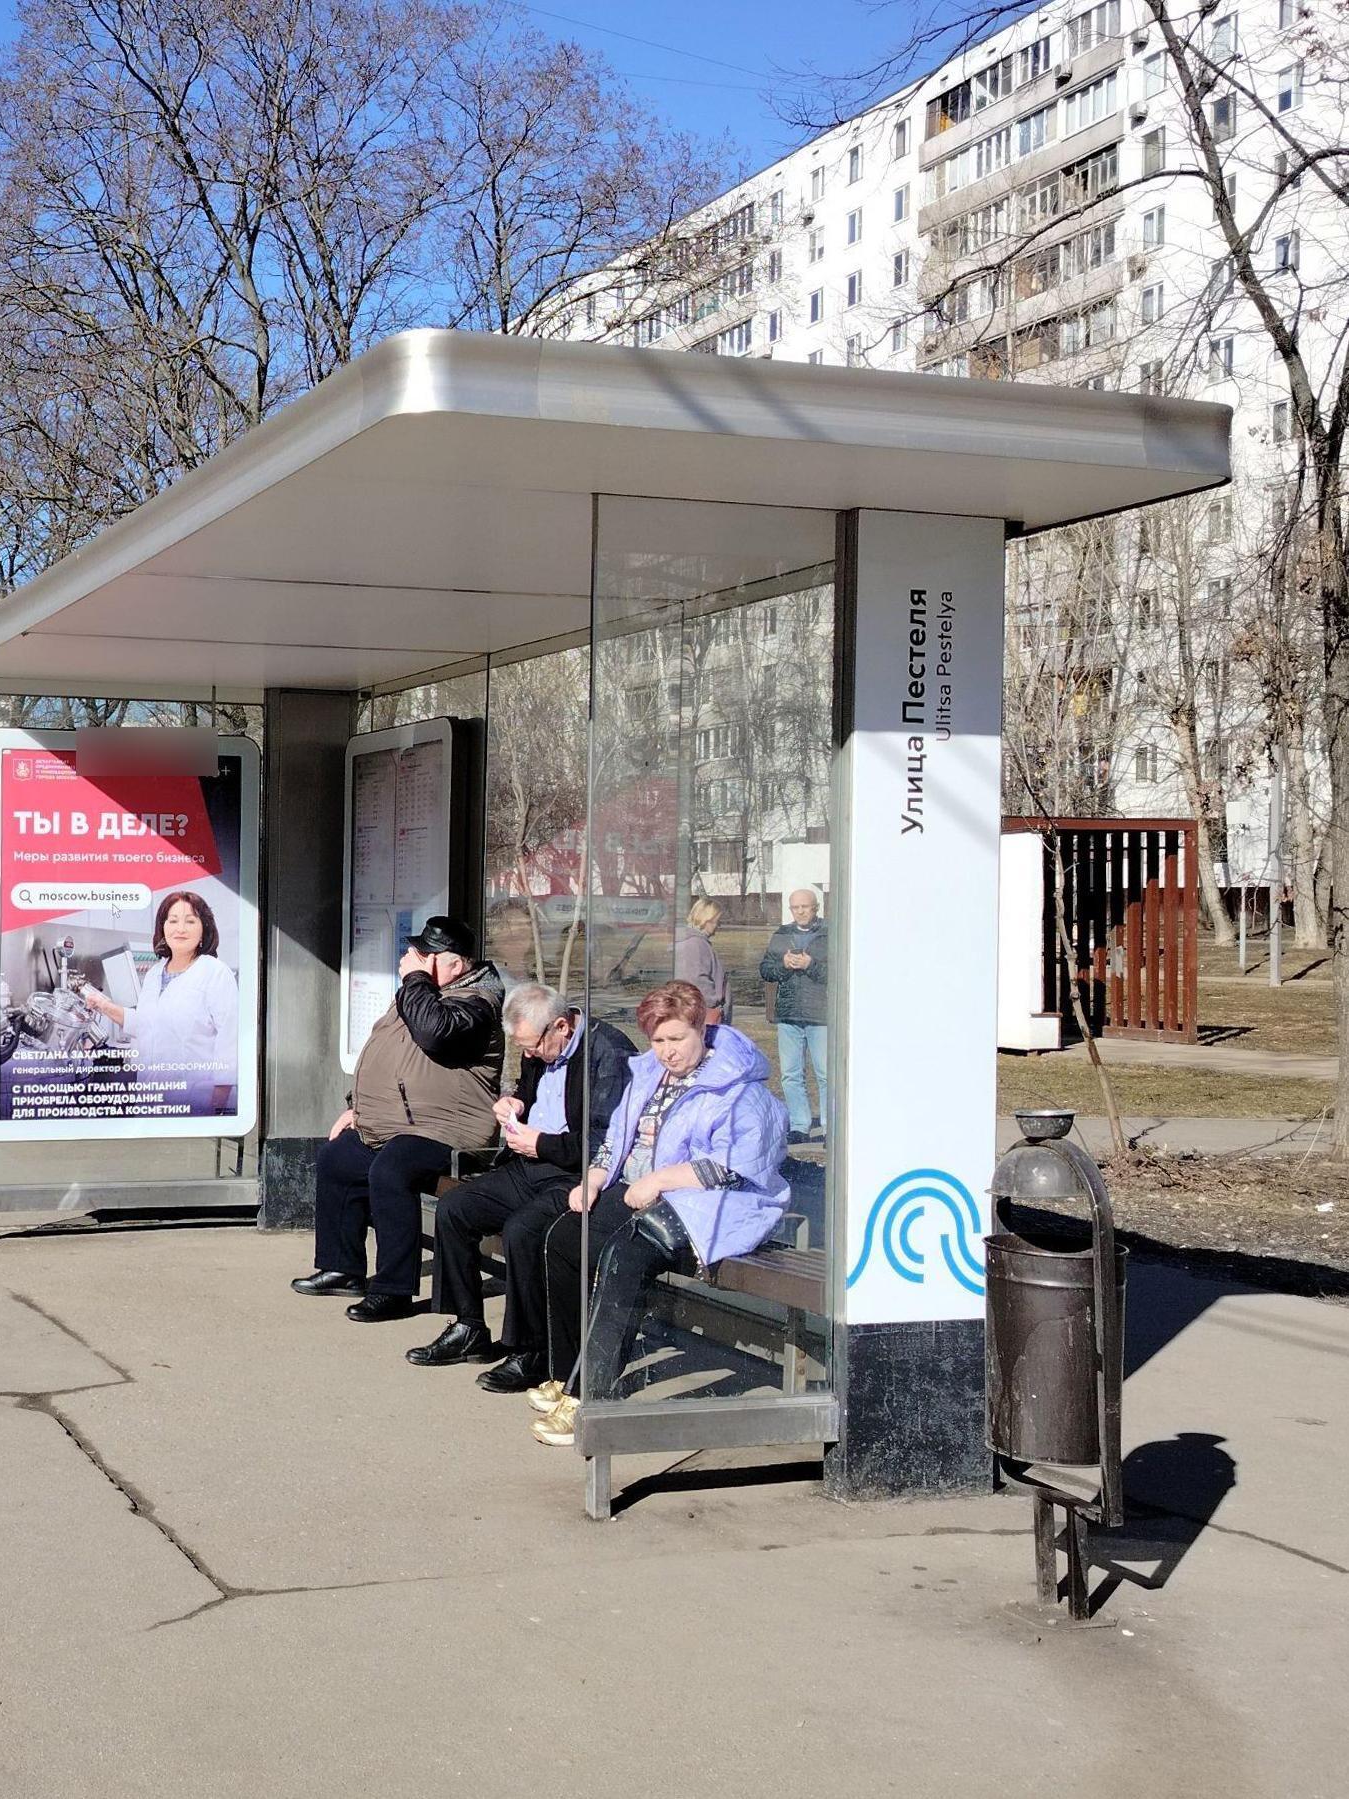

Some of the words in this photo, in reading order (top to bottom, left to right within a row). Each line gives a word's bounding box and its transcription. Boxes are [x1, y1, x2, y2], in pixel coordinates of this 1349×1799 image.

[936, 591, 956, 676] Pestelya
[901, 588, 927, 725] Пестеля
[935, 684, 952, 742] Ulitsa
[900, 735, 926, 836] Улица
[13, 811, 60, 835] ТЫ
[70, 812, 89, 835] В
[97, 812, 189, 840] ДЕЛЕ?
[13, 851, 49, 864] Меры
[52, 852, 109, 864] развития
[112, 853, 153, 863] твоего
[156, 851, 205, 863] бизнеса
[39, 890, 140, 902] moscow.business
[12, 1050, 68, 1060] СВЕТЛАНА
[71, 1049, 139, 1060] ЗАХАРЧЕНКО
[12, 1064, 74, 1075] генеральный
[75, 1064, 121, 1074] директор
[122, 1063, 146, 1072] ООО
[12, 1084, 22, 1094] С
[23, 1083, 86, 1094] ПОМОЩЬЮ
[87, 1082, 126, 1092] ГРАНТА
[127, 1081, 187, 1092] КОМПАНИЯ
[12, 1096, 77, 1106] ПРИОБРЕЛА
[78, 1093, 164, 1105] ОБОРУДОВАНИЕ
[12, 1108, 35, 1119] ДЛЯ
[37, 1106, 124, 1118] ПРОИЗВОДСТВА
[125, 1104, 191, 1115] КОСМЕТИКИ
